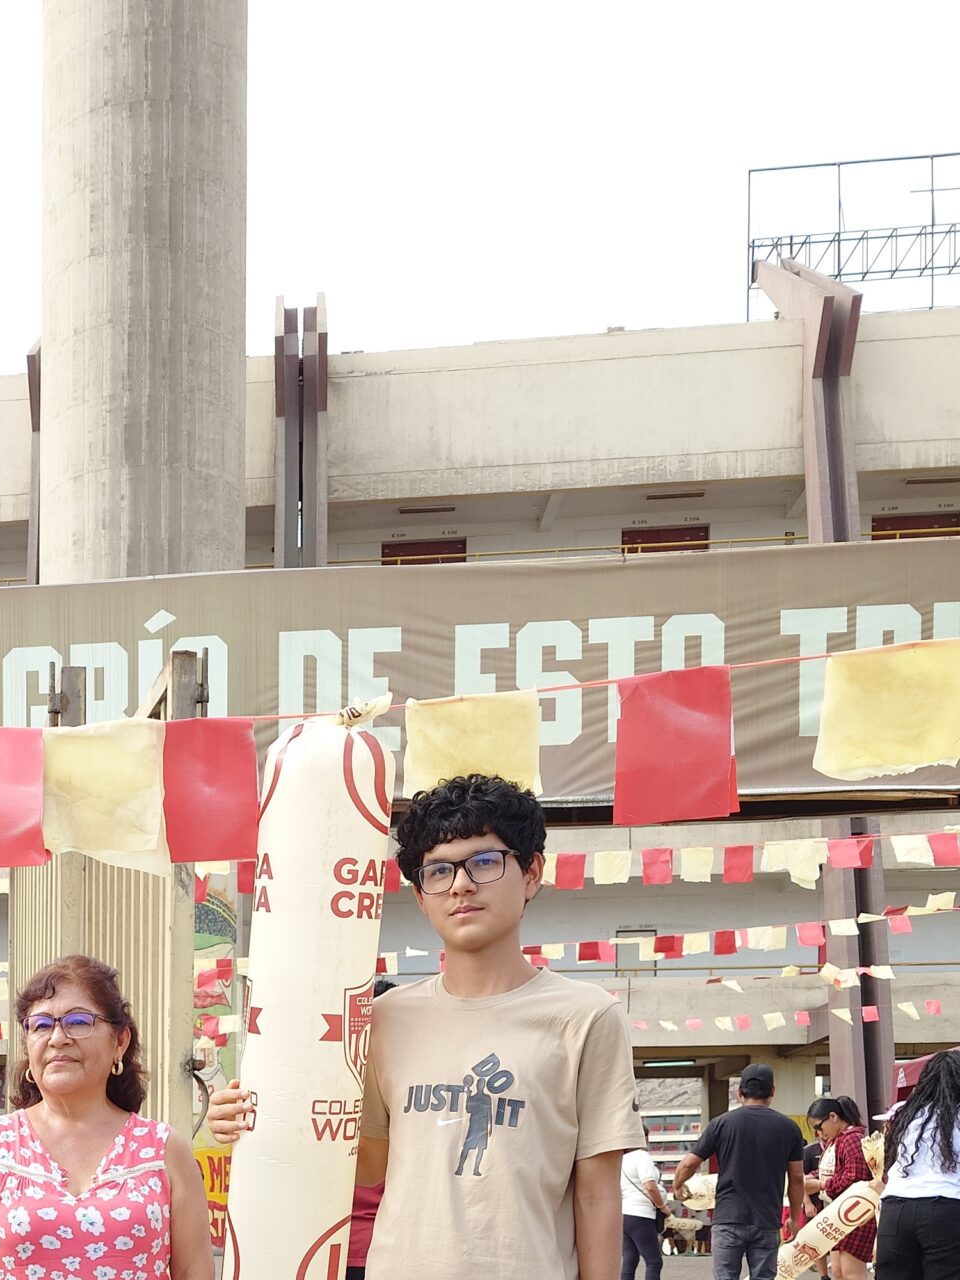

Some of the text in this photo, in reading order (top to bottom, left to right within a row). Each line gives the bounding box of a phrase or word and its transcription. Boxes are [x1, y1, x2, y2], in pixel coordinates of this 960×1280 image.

[404, 1053, 525, 1127] JUST DO IT
